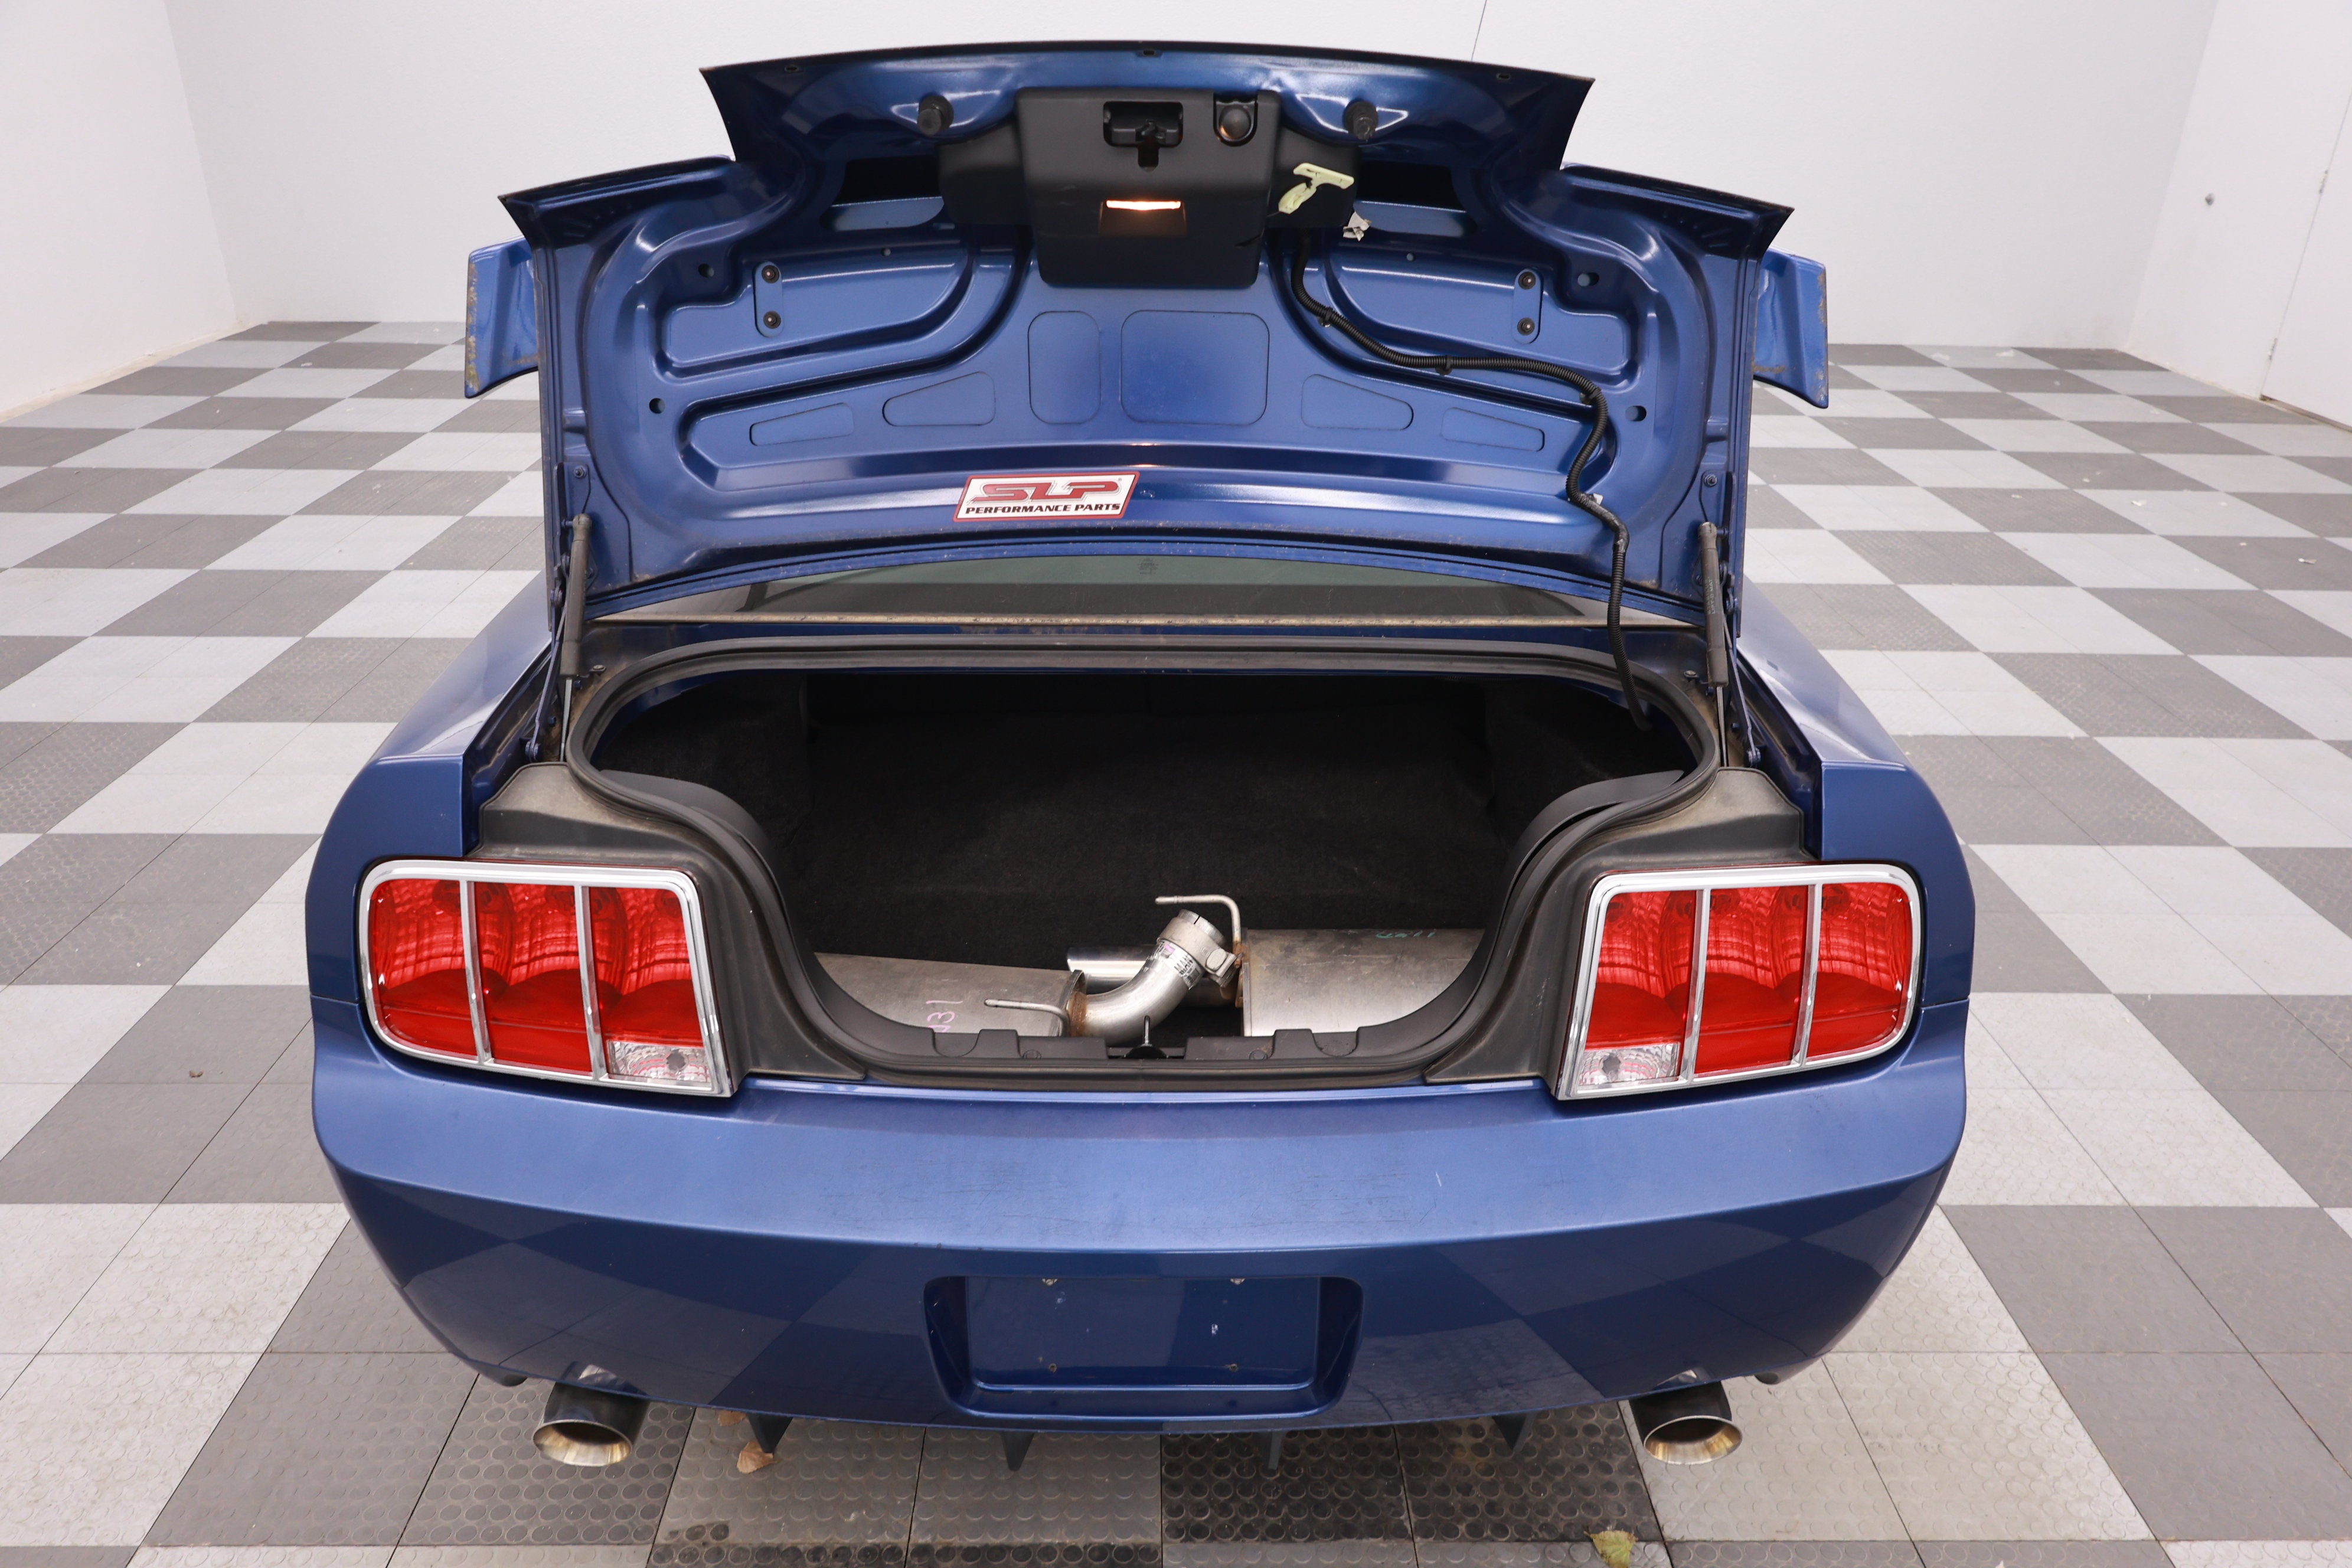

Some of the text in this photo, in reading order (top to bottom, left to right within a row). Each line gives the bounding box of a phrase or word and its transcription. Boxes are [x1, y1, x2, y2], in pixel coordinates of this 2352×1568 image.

[968, 480, 1121, 504] SLP
[965, 503, 1121, 514] PERFORMANCE PARTS
